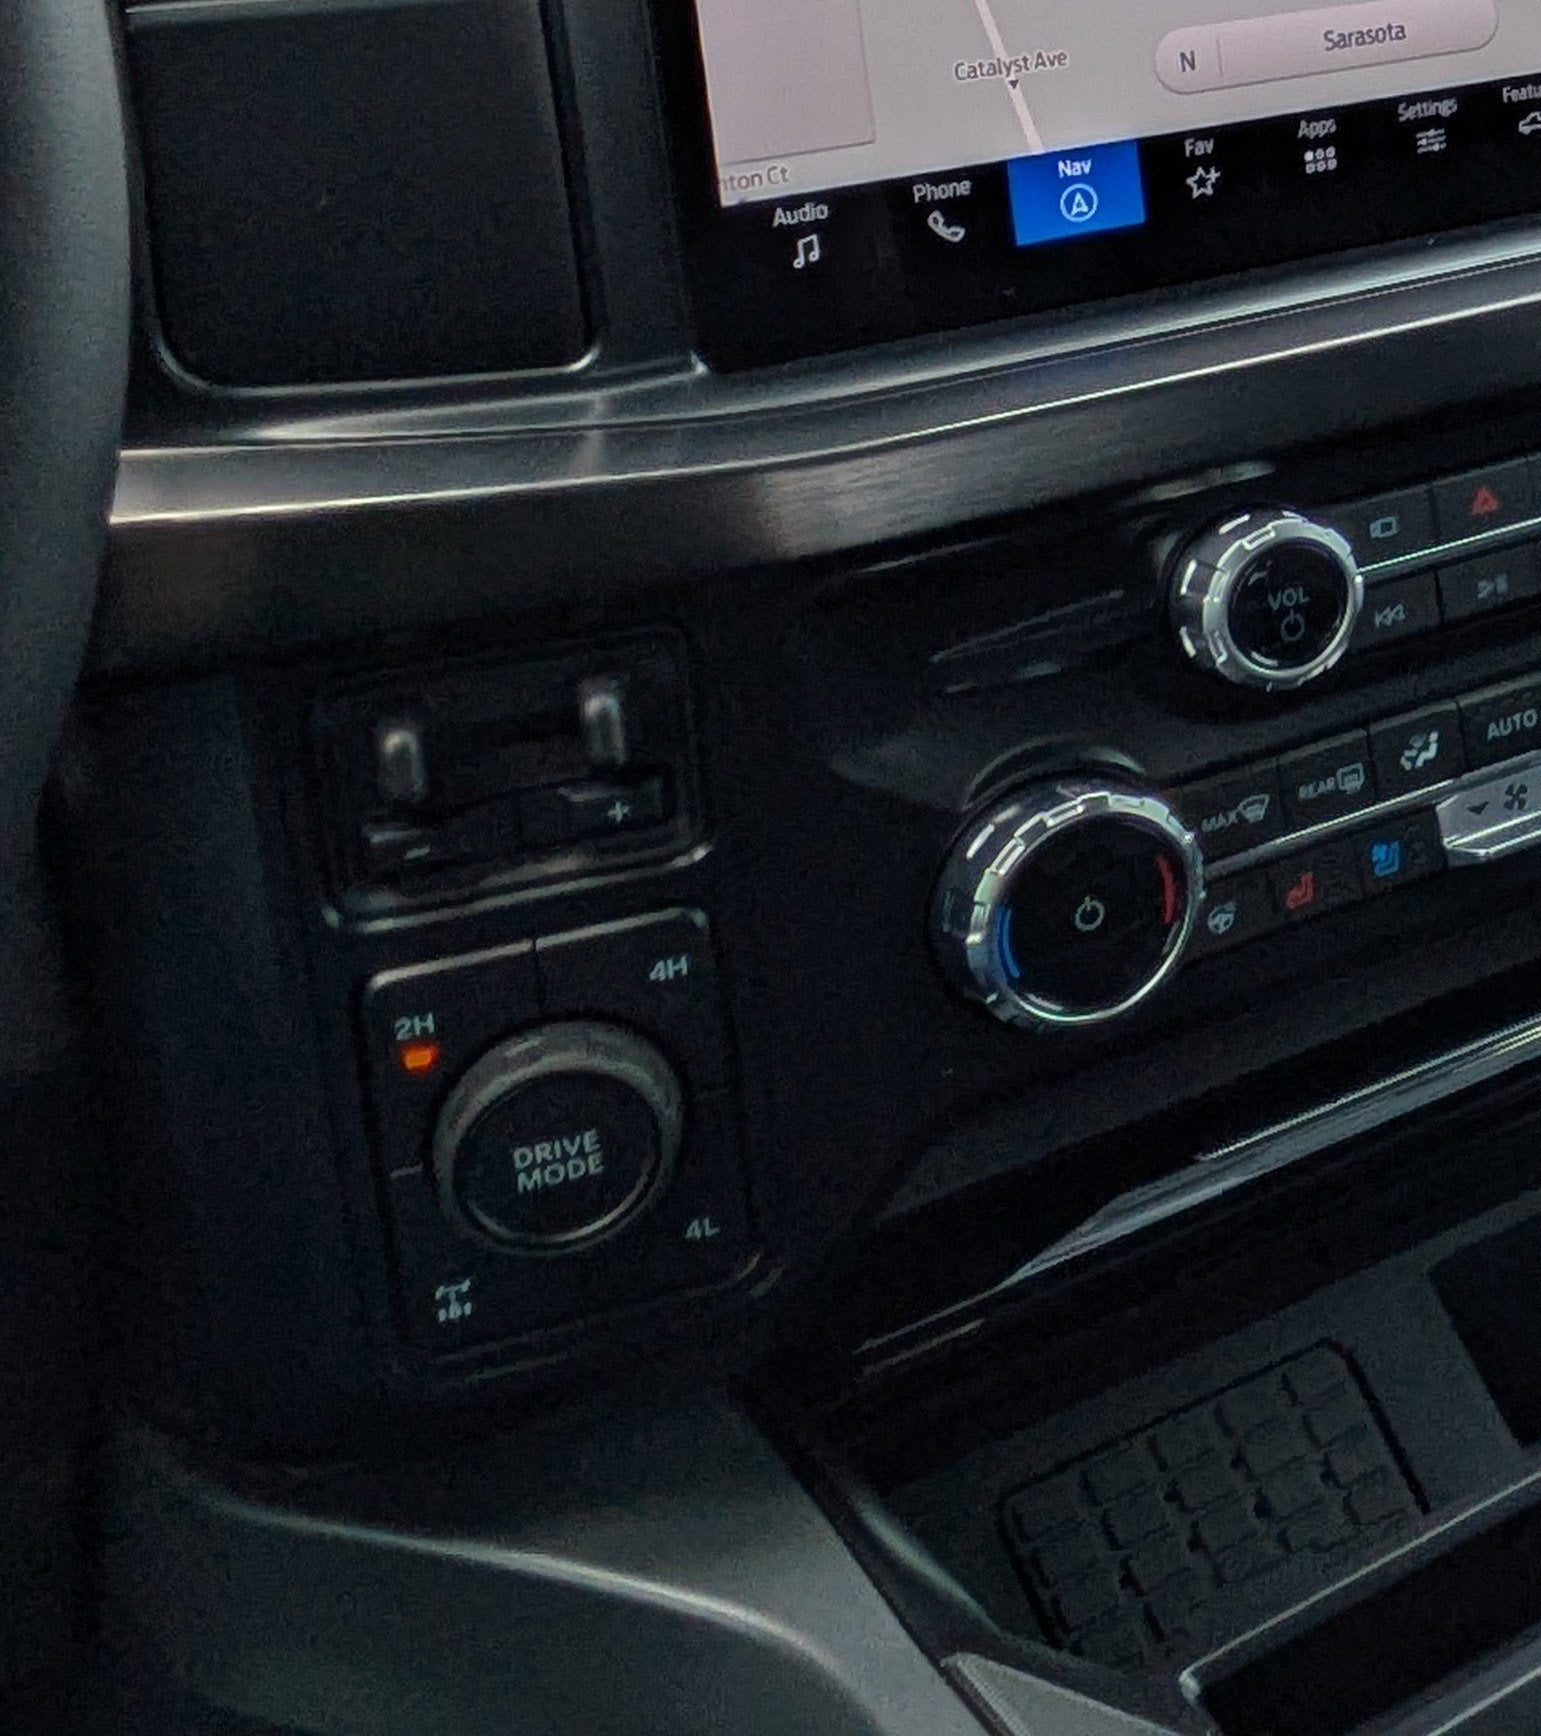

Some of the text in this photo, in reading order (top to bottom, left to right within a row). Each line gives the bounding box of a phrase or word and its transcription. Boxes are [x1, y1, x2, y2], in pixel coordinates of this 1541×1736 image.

[1323, 22, 1406, 52] Sarasota
[954, 51, 1068, 81] Catalyst Ave
[1179, 51, 1196, 72] N
[1398, 96, 1458, 120] Settings
[1298, 117, 1337, 139] Apps
[1184, 137, 1215, 156] Fav
[767, 165, 790, 185] Ct
[1057, 158, 1092, 178] Nav
[913, 178, 972, 202] Phone
[773, 201, 828, 228] Audio
[1267, 588, 1312, 613] VOL
[1486, 707, 1538, 742] AUTO
[1201, 809, 1239, 833] MAX
[648, 954, 689, 984] 4H
[395, 1013, 436, 1041] 2H
[512, 1127, 602, 1169] DRIVE
[516, 1152, 605, 1194] MODE
[685, 1219, 718, 1240] 4L
